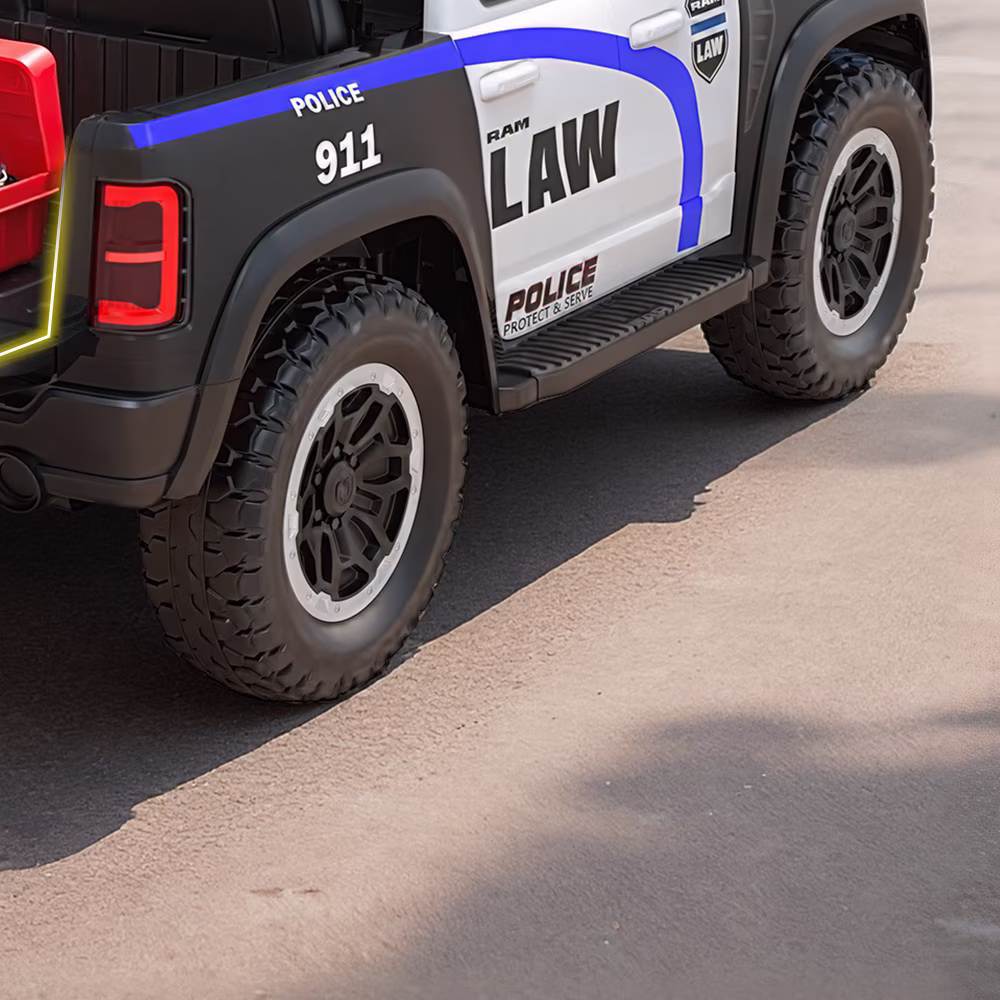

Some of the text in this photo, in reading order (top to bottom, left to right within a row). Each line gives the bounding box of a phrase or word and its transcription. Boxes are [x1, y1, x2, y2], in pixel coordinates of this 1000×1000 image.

[696, 34, 724, 65] LAW
[289, 82, 365, 118] POLICE
[315, 123, 382, 185] 911
[486, 116, 530, 145] RAM
[490, 99, 620, 230] LAW
[503, 285, 594, 337] PROTECT & SERVE
[504, 255, 599, 323] POLICE
